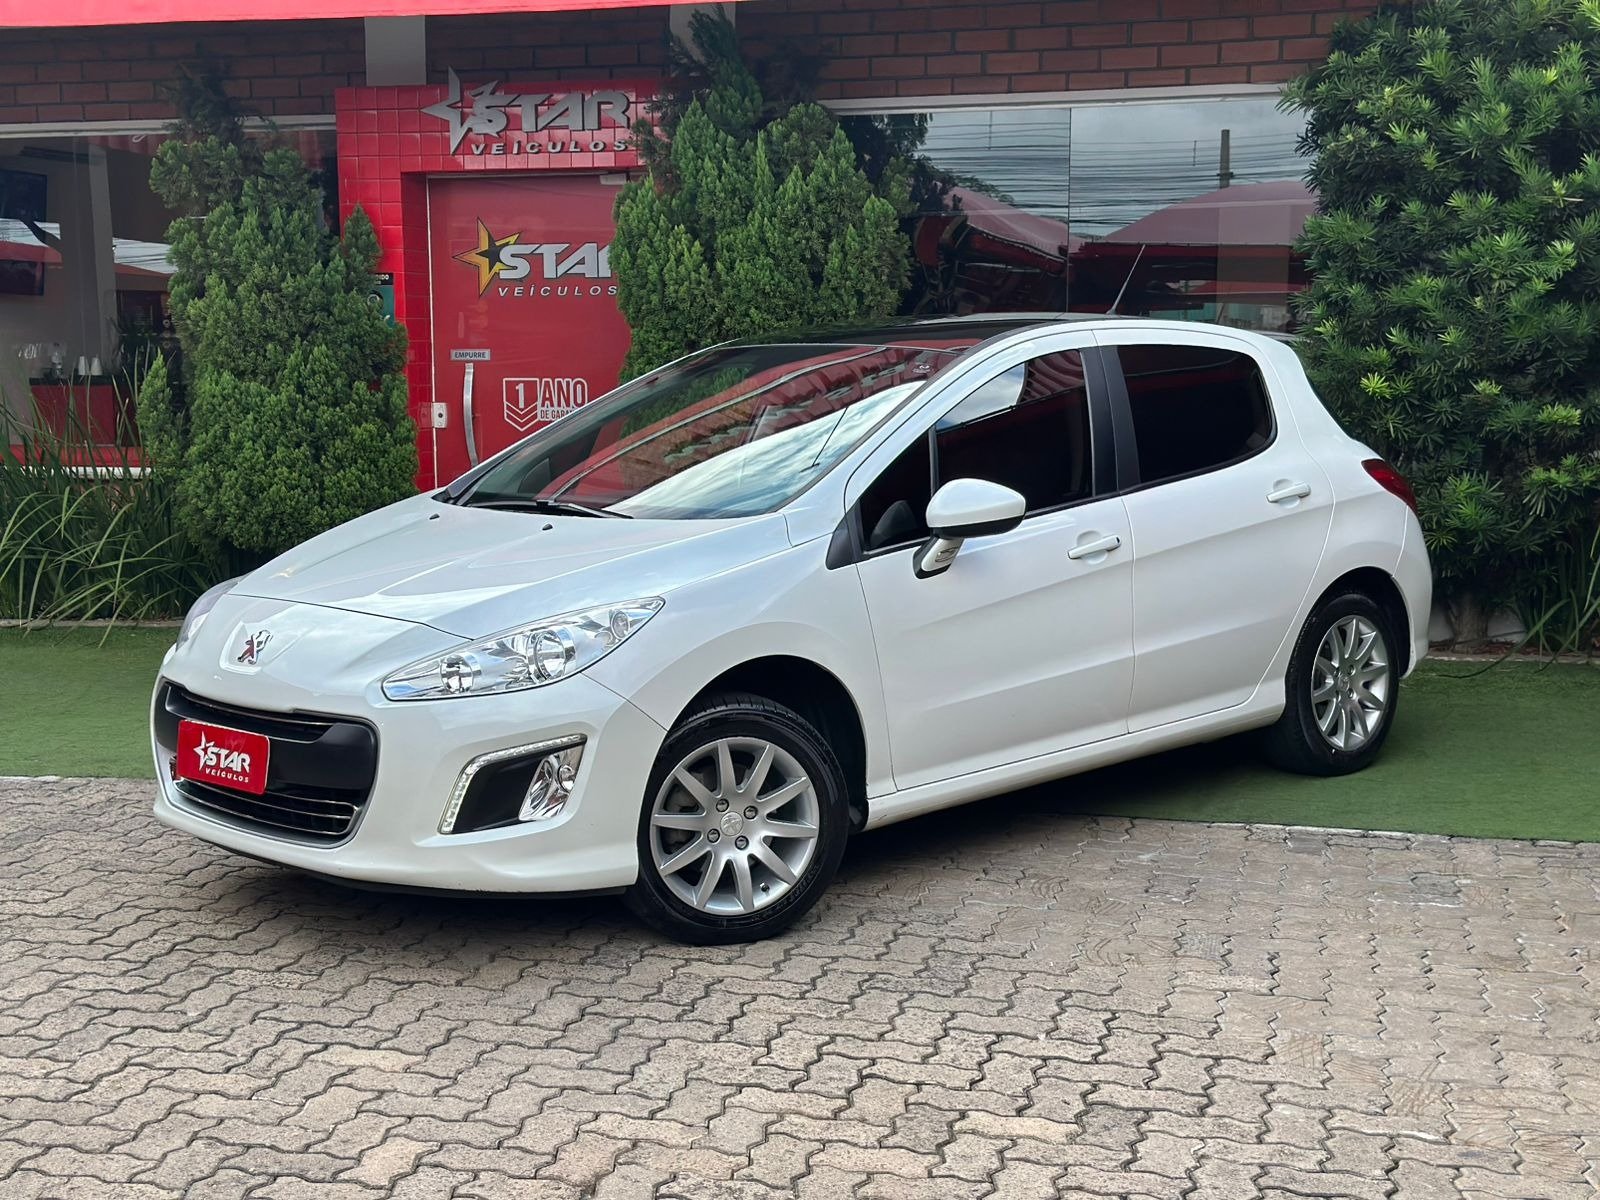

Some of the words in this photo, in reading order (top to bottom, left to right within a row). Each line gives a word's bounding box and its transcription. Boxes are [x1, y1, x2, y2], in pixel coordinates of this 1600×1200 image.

[471, 90, 630, 137] STAR
[472, 139, 629, 155] VEÍCULOS
[498, 284, 618, 297] VEÍCULOS
[454, 351, 486, 359] EMPURRE
[515, 382, 525, 409] 1
[540, 378, 587, 408] ANO
[540, 409, 550, 419] DE
[551, 409, 573, 419] GARA
[205, 746, 251, 774] STAR
[205, 767, 249, 783] VEÍCULOS
